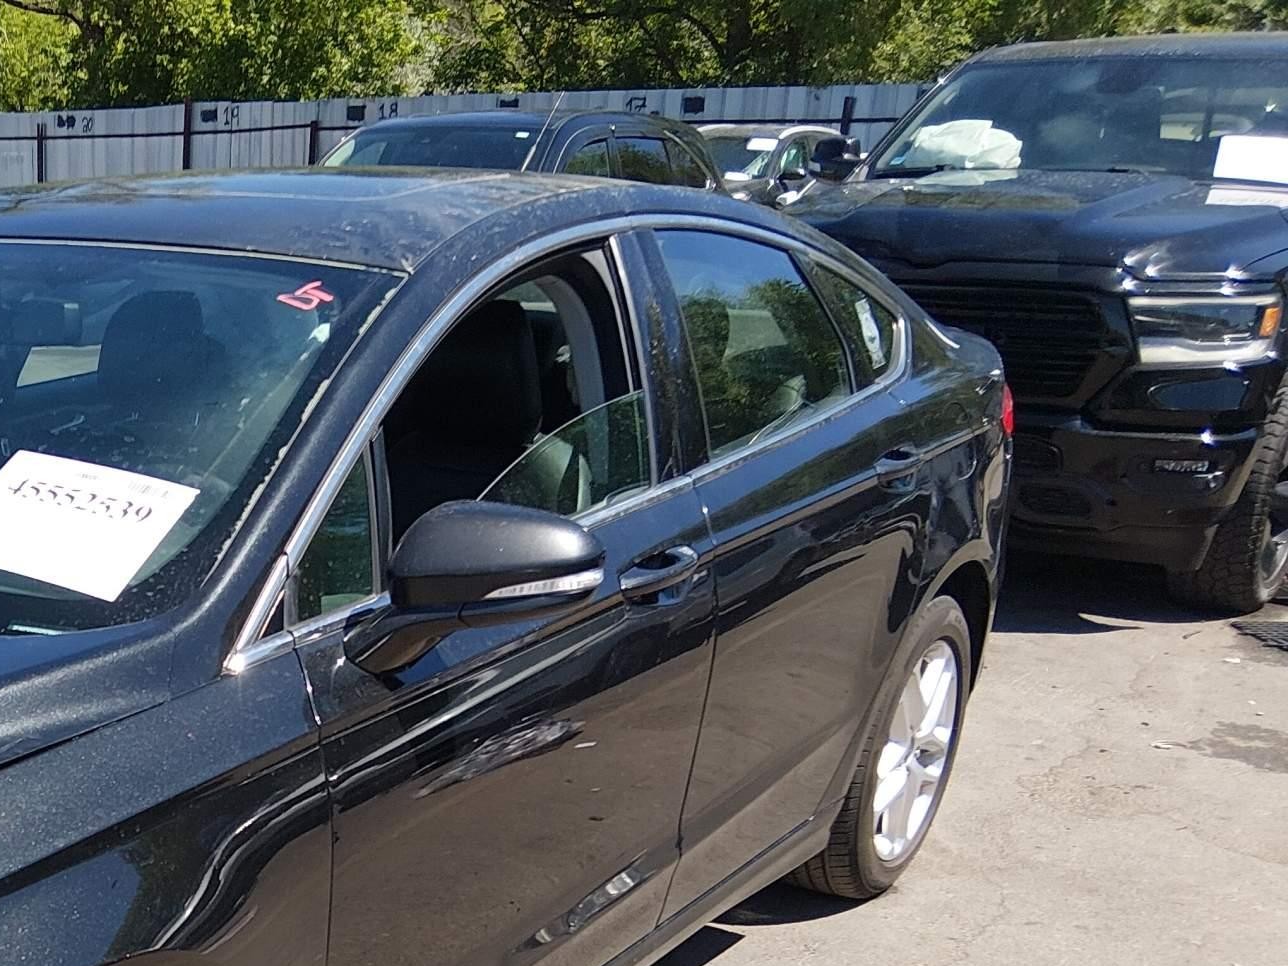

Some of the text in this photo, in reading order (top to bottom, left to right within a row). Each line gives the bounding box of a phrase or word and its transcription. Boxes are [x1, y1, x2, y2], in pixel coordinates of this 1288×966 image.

[223, 105, 240, 127] 19
[378, 102, 399, 120] 18
[81, 115, 94, 133] 20
[8, 479, 153, 522] 45552539
